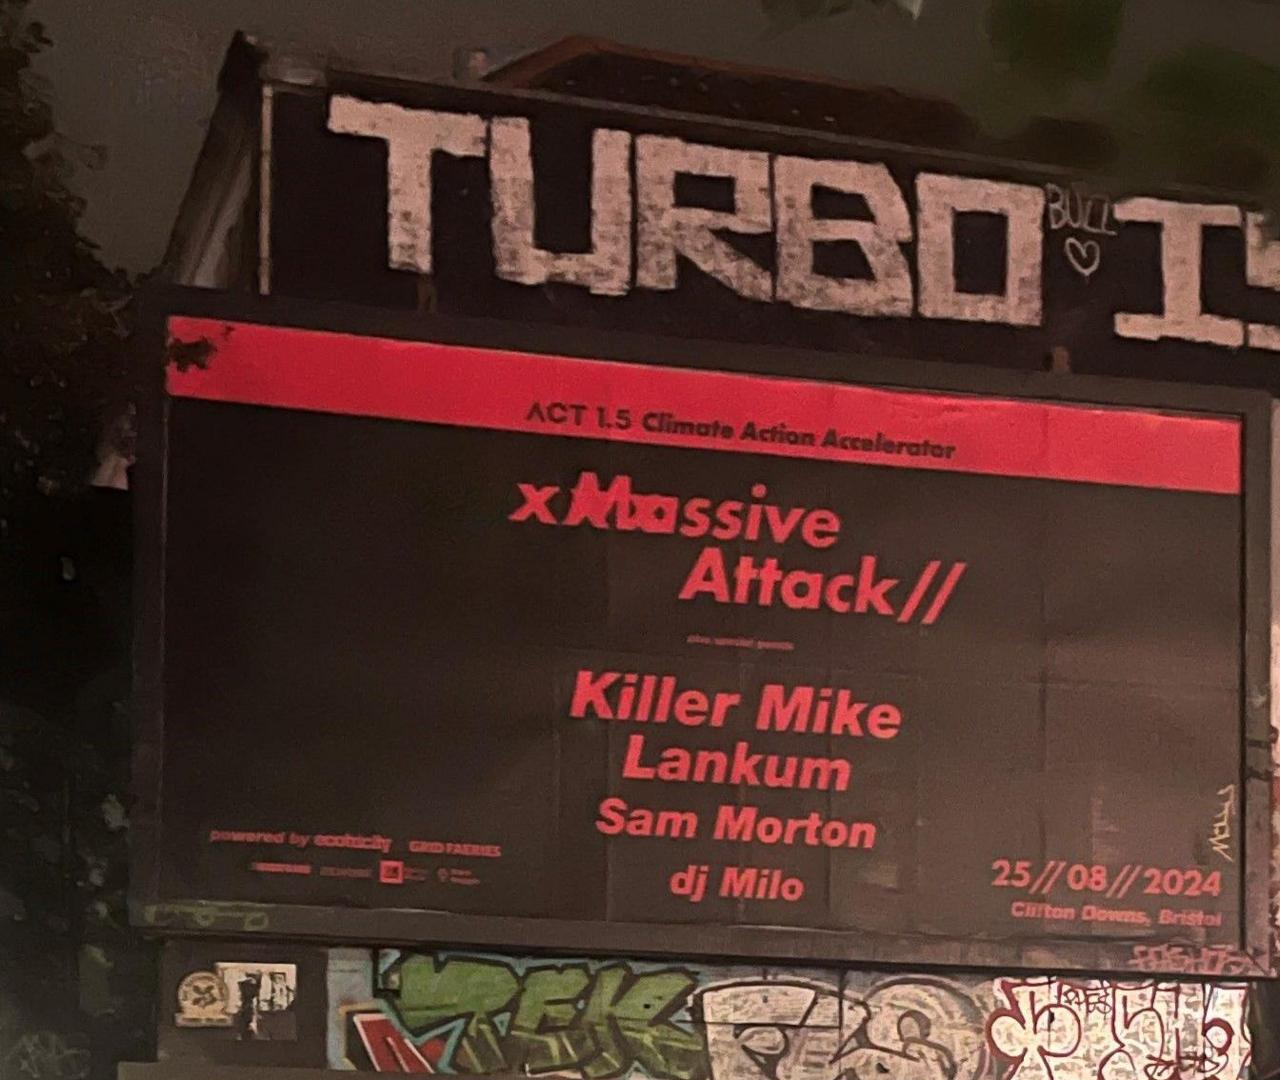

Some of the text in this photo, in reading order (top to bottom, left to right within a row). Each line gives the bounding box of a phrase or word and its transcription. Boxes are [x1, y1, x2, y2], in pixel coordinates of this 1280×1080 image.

[328, 94, 1044, 328] TURBO
[598, 406, 632, 431] 1.5
[642, 411, 734, 441] Climate
[740, 419, 816, 448] Action
[821, 427, 957, 461] Accelerator
[569, 669, 903, 740] Killer Mike
[621, 733, 853, 793] Lankum
[594, 796, 878, 850] Sam Morton
[669, 864, 805, 902] dj Milo
[1010, 900, 1076, 921] Clifton
[1157, 907, 1222, 928] Bristol
